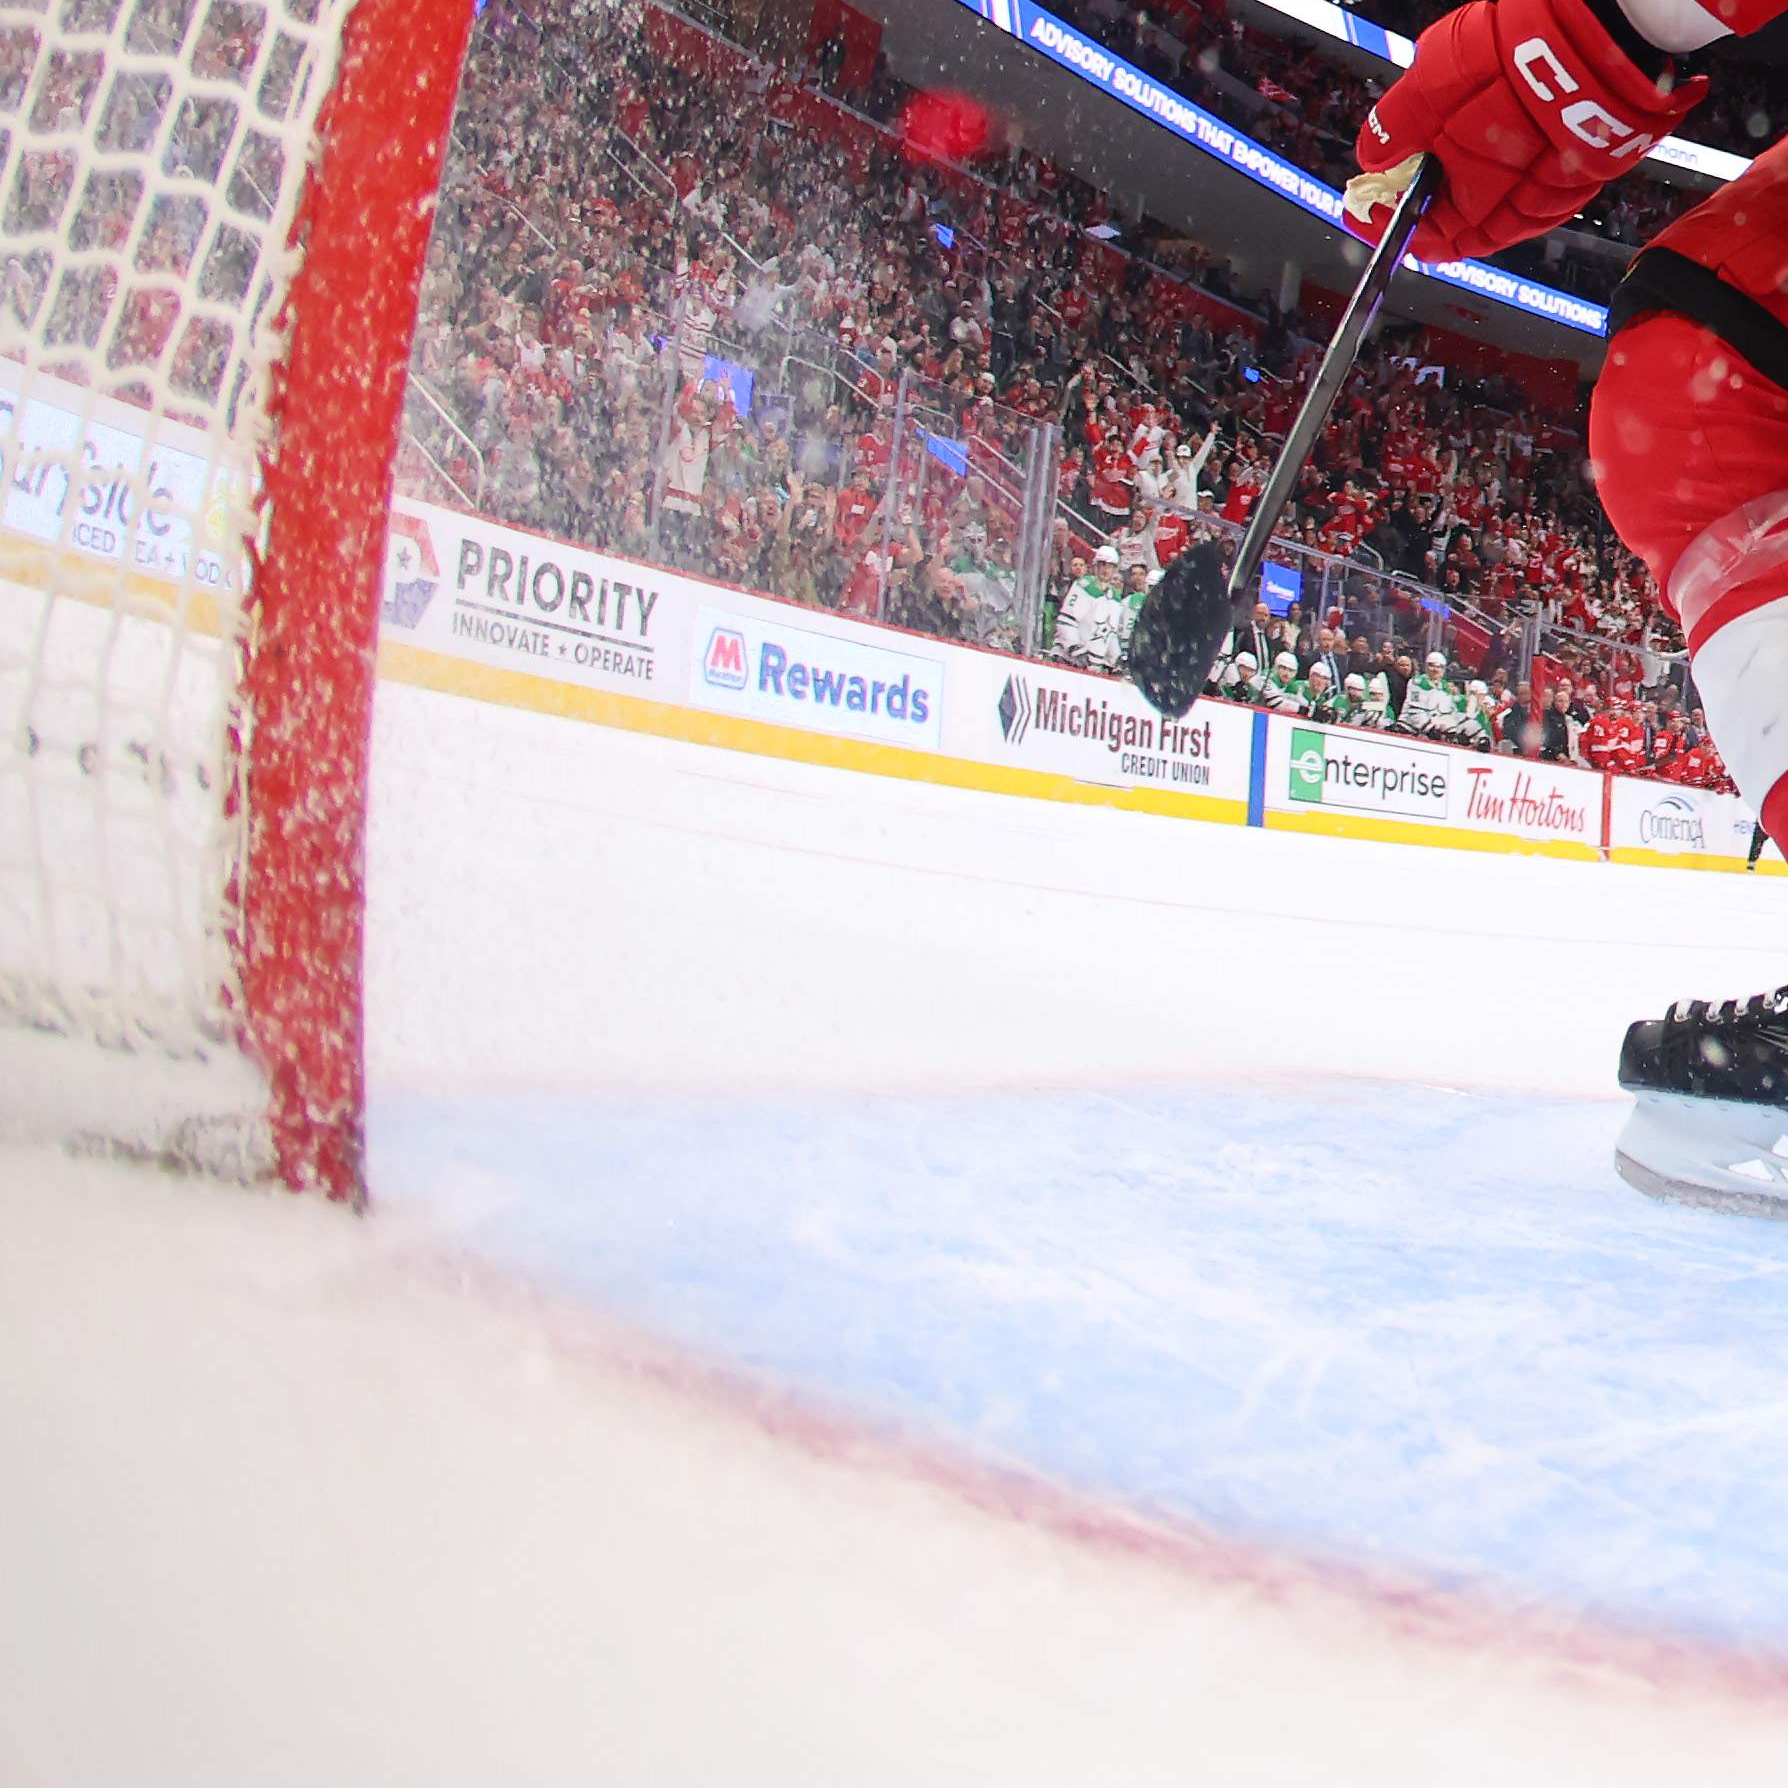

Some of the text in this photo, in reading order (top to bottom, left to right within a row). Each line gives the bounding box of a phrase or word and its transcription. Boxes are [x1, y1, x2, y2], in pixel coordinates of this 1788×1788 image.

[1030, 16, 1339, 217] ADVISORY SOLUTIONS THAT EMPOWER YOUR
[1436, 260, 1601, 330] ADVISORY SOLUTIONS
[455, 538, 659, 638] PRIORITY
[452, 612, 654, 682] INNOVATE OPERATE
[758, 641, 930, 724] Rewards
[1036, 687, 1211, 759] Michigan First
[1121, 754, 1210, 786] CREDIT UNION
[1290, 749, 1447, 799] enterprise
[1466, 767, 1586, 833] Tim Hortons
[1640, 810, 1706, 850] Comerica
